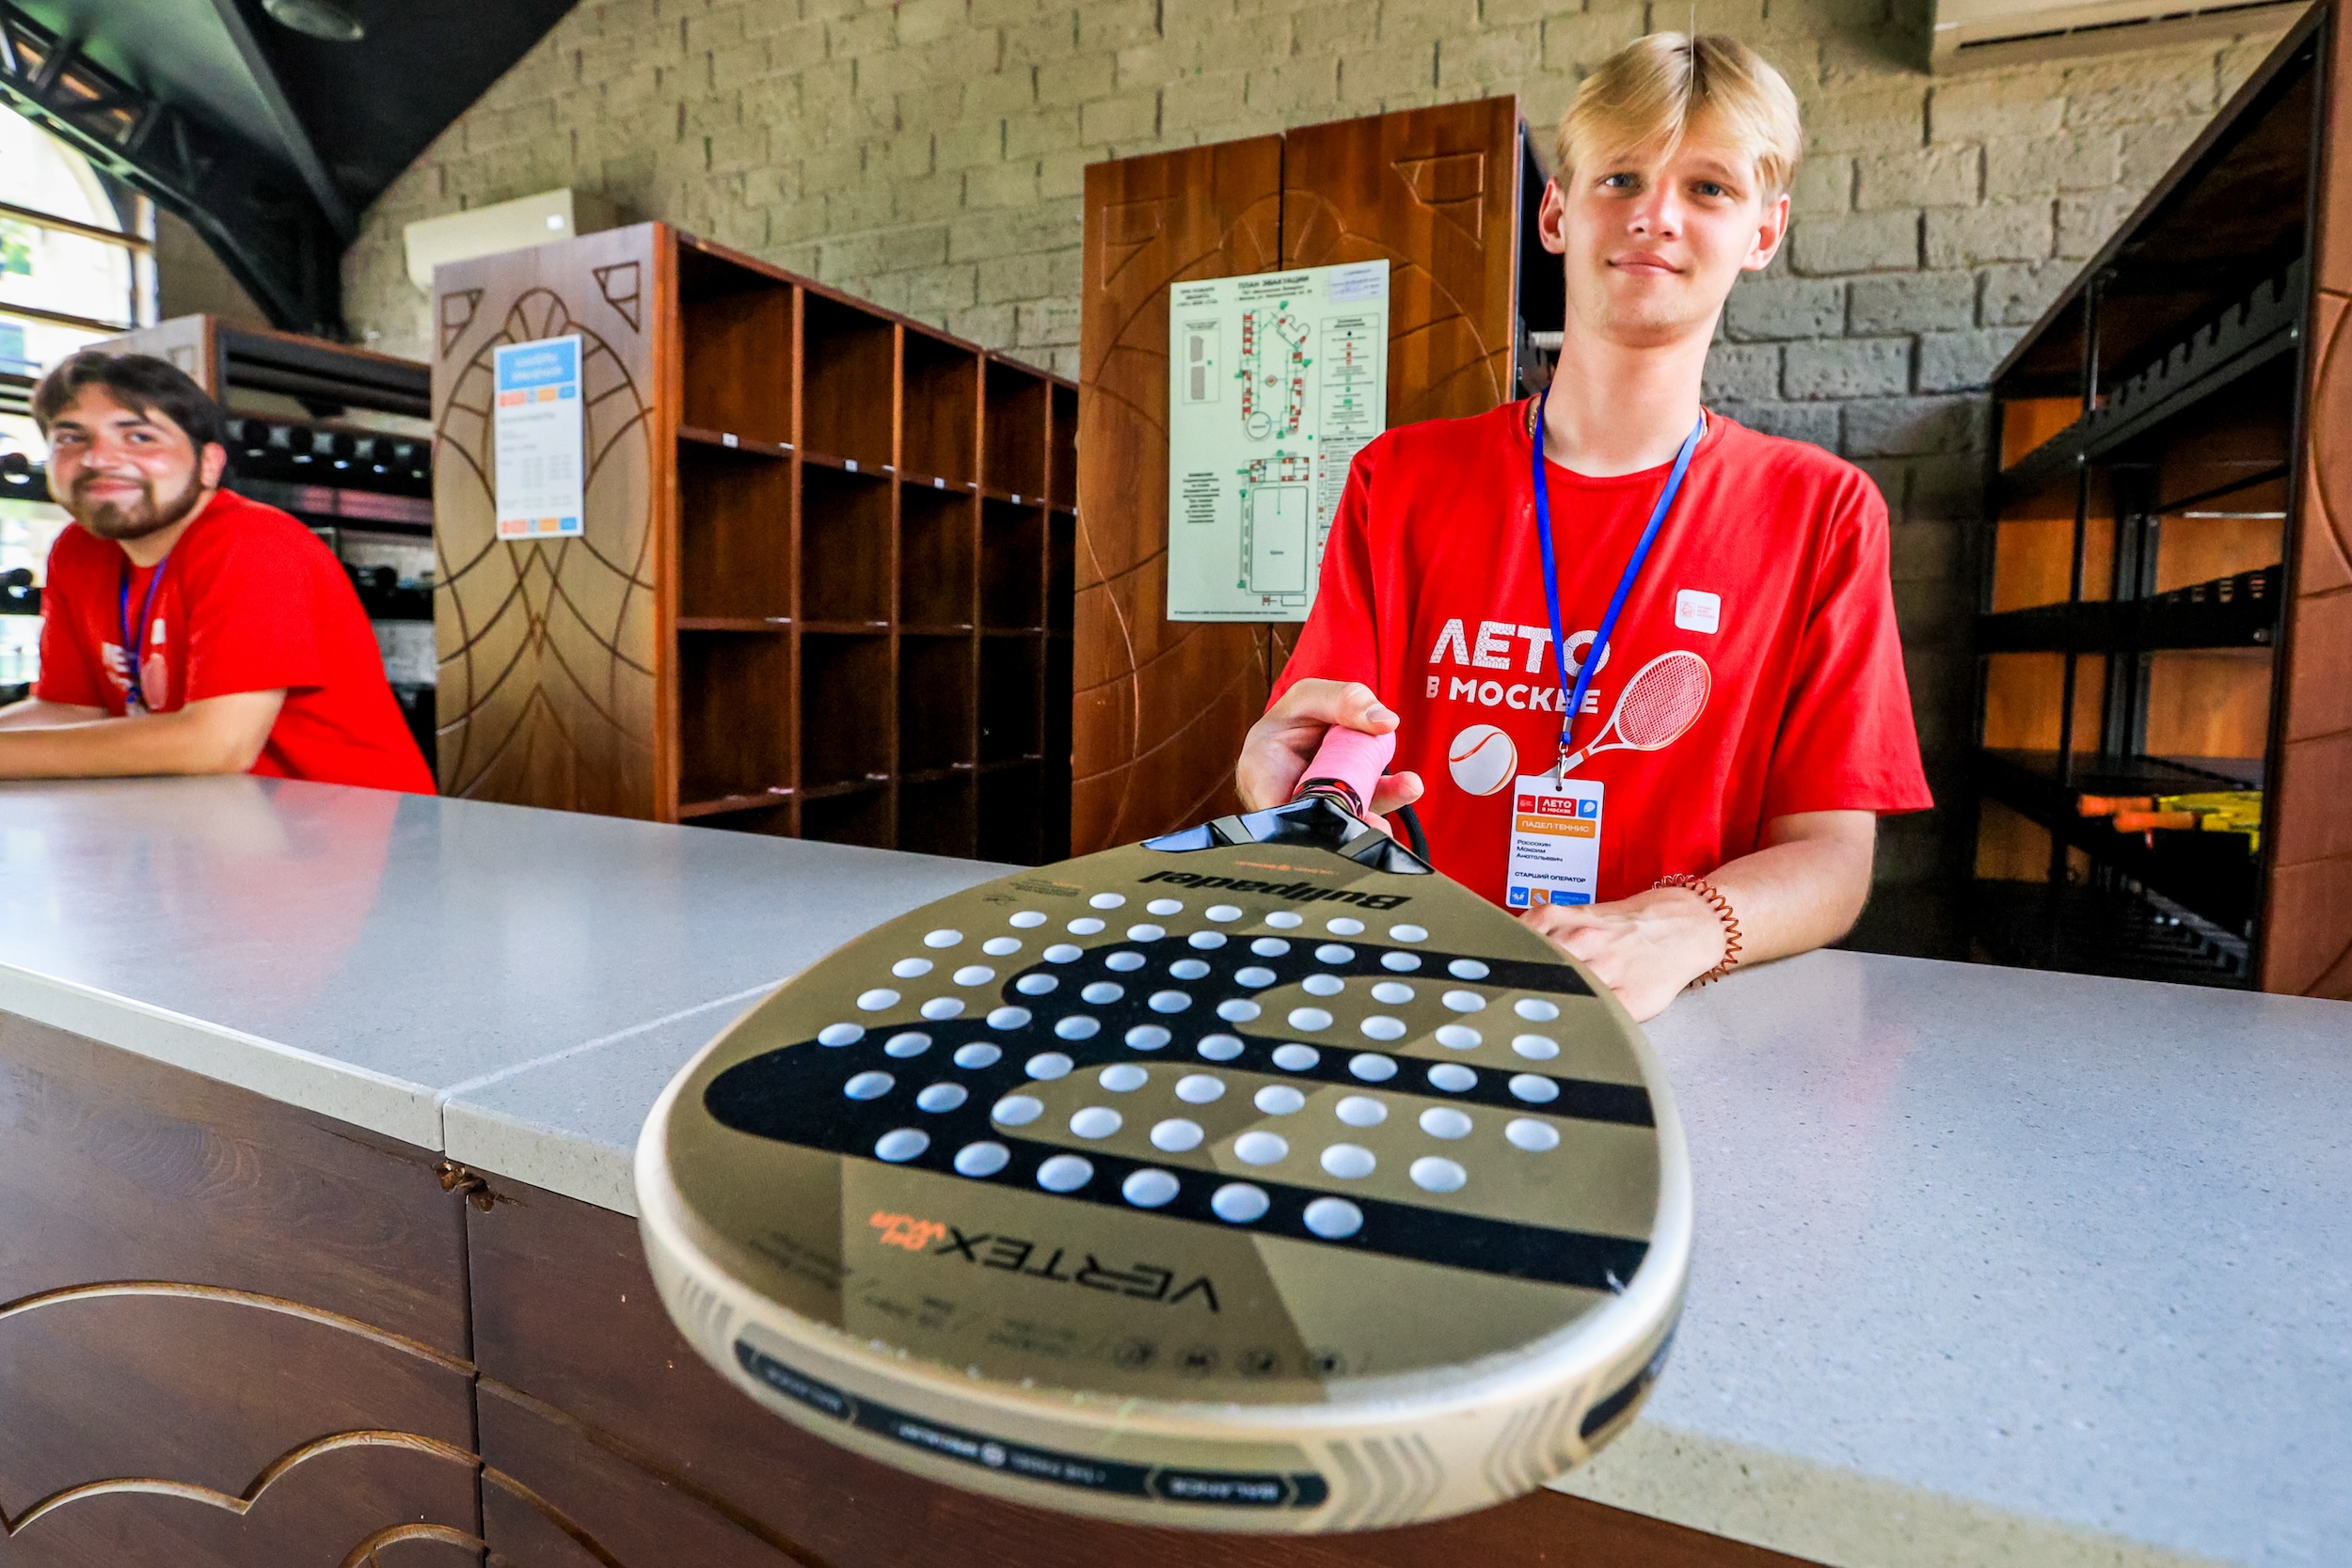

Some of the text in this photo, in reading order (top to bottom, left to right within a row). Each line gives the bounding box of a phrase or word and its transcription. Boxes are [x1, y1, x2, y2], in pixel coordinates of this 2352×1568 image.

[1429, 618, 1611, 677] ЛЕТО
[1426, 675, 1439, 698] В
[1542, 799, 1572, 808] ЛЕТО
[1521, 820, 1589, 832] ПАДЕЛ-ТЕННИС
[1516, 852, 1563, 862] Анатольевич
[1515, 871, 1586, 883] СТАРШИЙ ОПЕРАТОР
[1138, 870, 1412, 911] Bullpadel
[935, 1226, 1220, 1313] VERTEX
